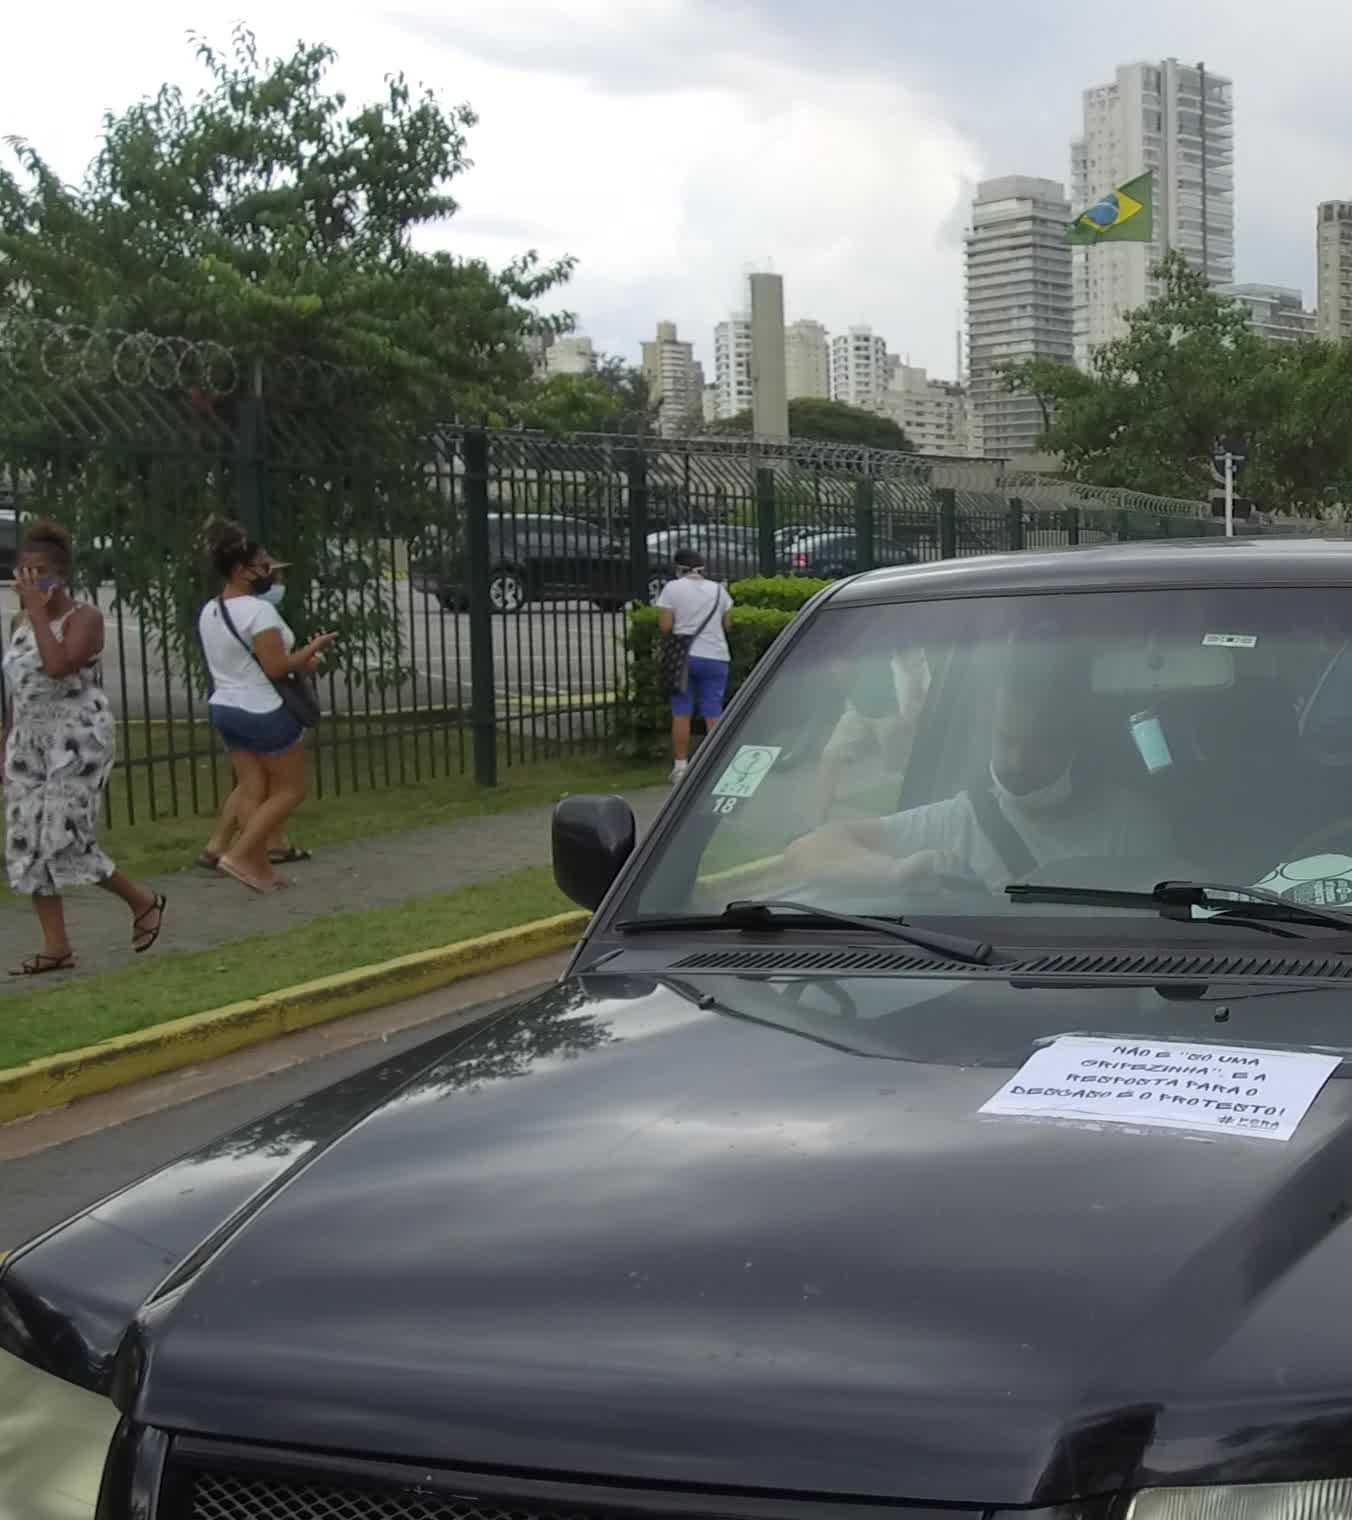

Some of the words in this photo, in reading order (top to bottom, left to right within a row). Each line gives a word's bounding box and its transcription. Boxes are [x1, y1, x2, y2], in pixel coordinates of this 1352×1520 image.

[712, 797, 737, 814] 18
[1218, 1054, 1260, 1067] UMA
[1065, 1072, 1179, 1088] RESPOSTA
[1185, 1080, 1241, 1096] PARA
[1245, 1087, 1259, 1098] O
[1252, 1072, 1267, 1082] A
[1009, 1085, 1113, 1099] DESCASO
[1138, 1091, 1153, 1101] O
[1158, 1092, 1287, 1117] PROTESTO!
